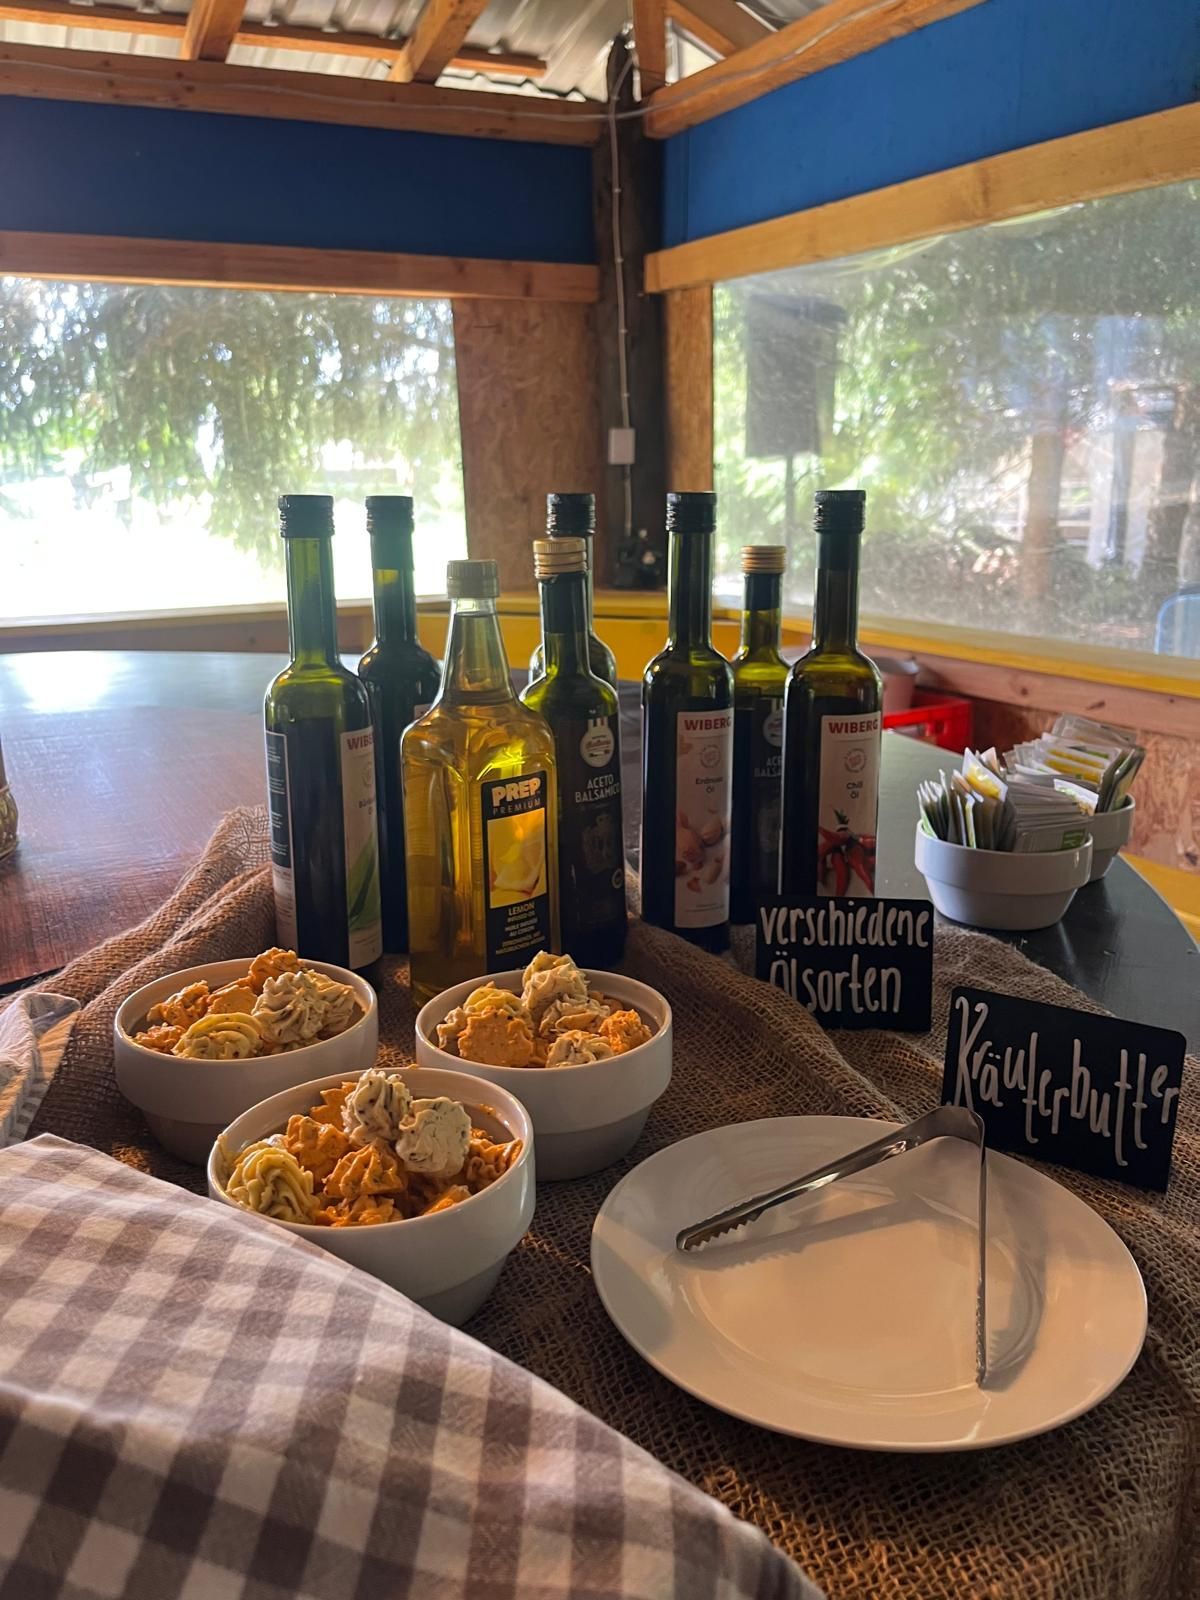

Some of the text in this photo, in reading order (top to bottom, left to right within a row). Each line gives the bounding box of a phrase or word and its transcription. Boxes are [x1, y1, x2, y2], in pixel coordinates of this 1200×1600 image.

[684, 717, 731, 731] WIBERG
[829, 719, 878, 734] WIBERG
[587, 773, 614, 790] ACETO
[491, 777, 541, 807] PREP
[493, 797, 541, 816] PREMIUM
[508, 901, 535, 916] LEMON
[759, 900, 930, 948] verschiedene
[769, 950, 902, 1014] Ölsorten
[955, 996, 1180, 1167] Kräuterbutter
